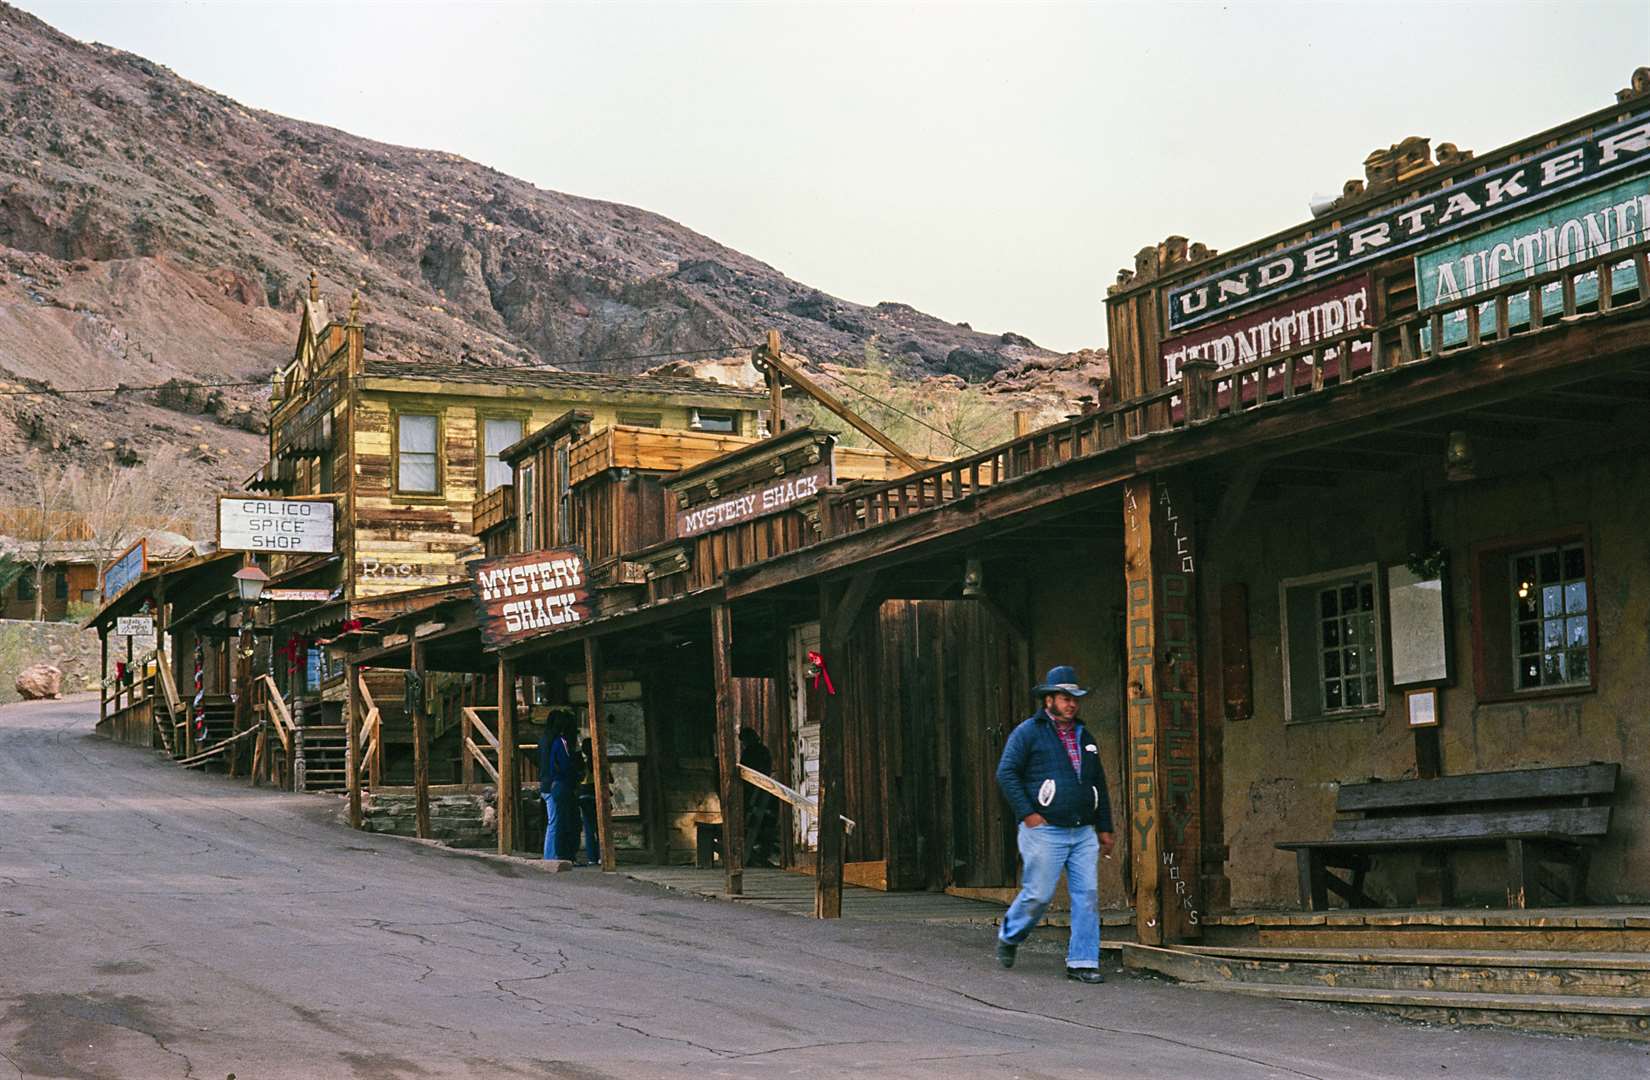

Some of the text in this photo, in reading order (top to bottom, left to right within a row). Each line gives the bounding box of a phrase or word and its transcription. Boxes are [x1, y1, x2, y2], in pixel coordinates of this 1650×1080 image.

[1435, 194, 1650, 322] AUCTIONE
[243, 501, 311, 516] CALICO
[249, 519, 305, 533] SPICE
[685, 475, 818, 532] MYSTERY SHACK
[252, 535, 301, 549] SHOP
[479, 557, 581, 600] MYSTERY
[502, 592, 580, 632] SHACK
[1129, 579, 1153, 851] POTTERY
[1161, 574, 1195, 845] POTTERY
[1162, 851, 1199, 926] WORKS
